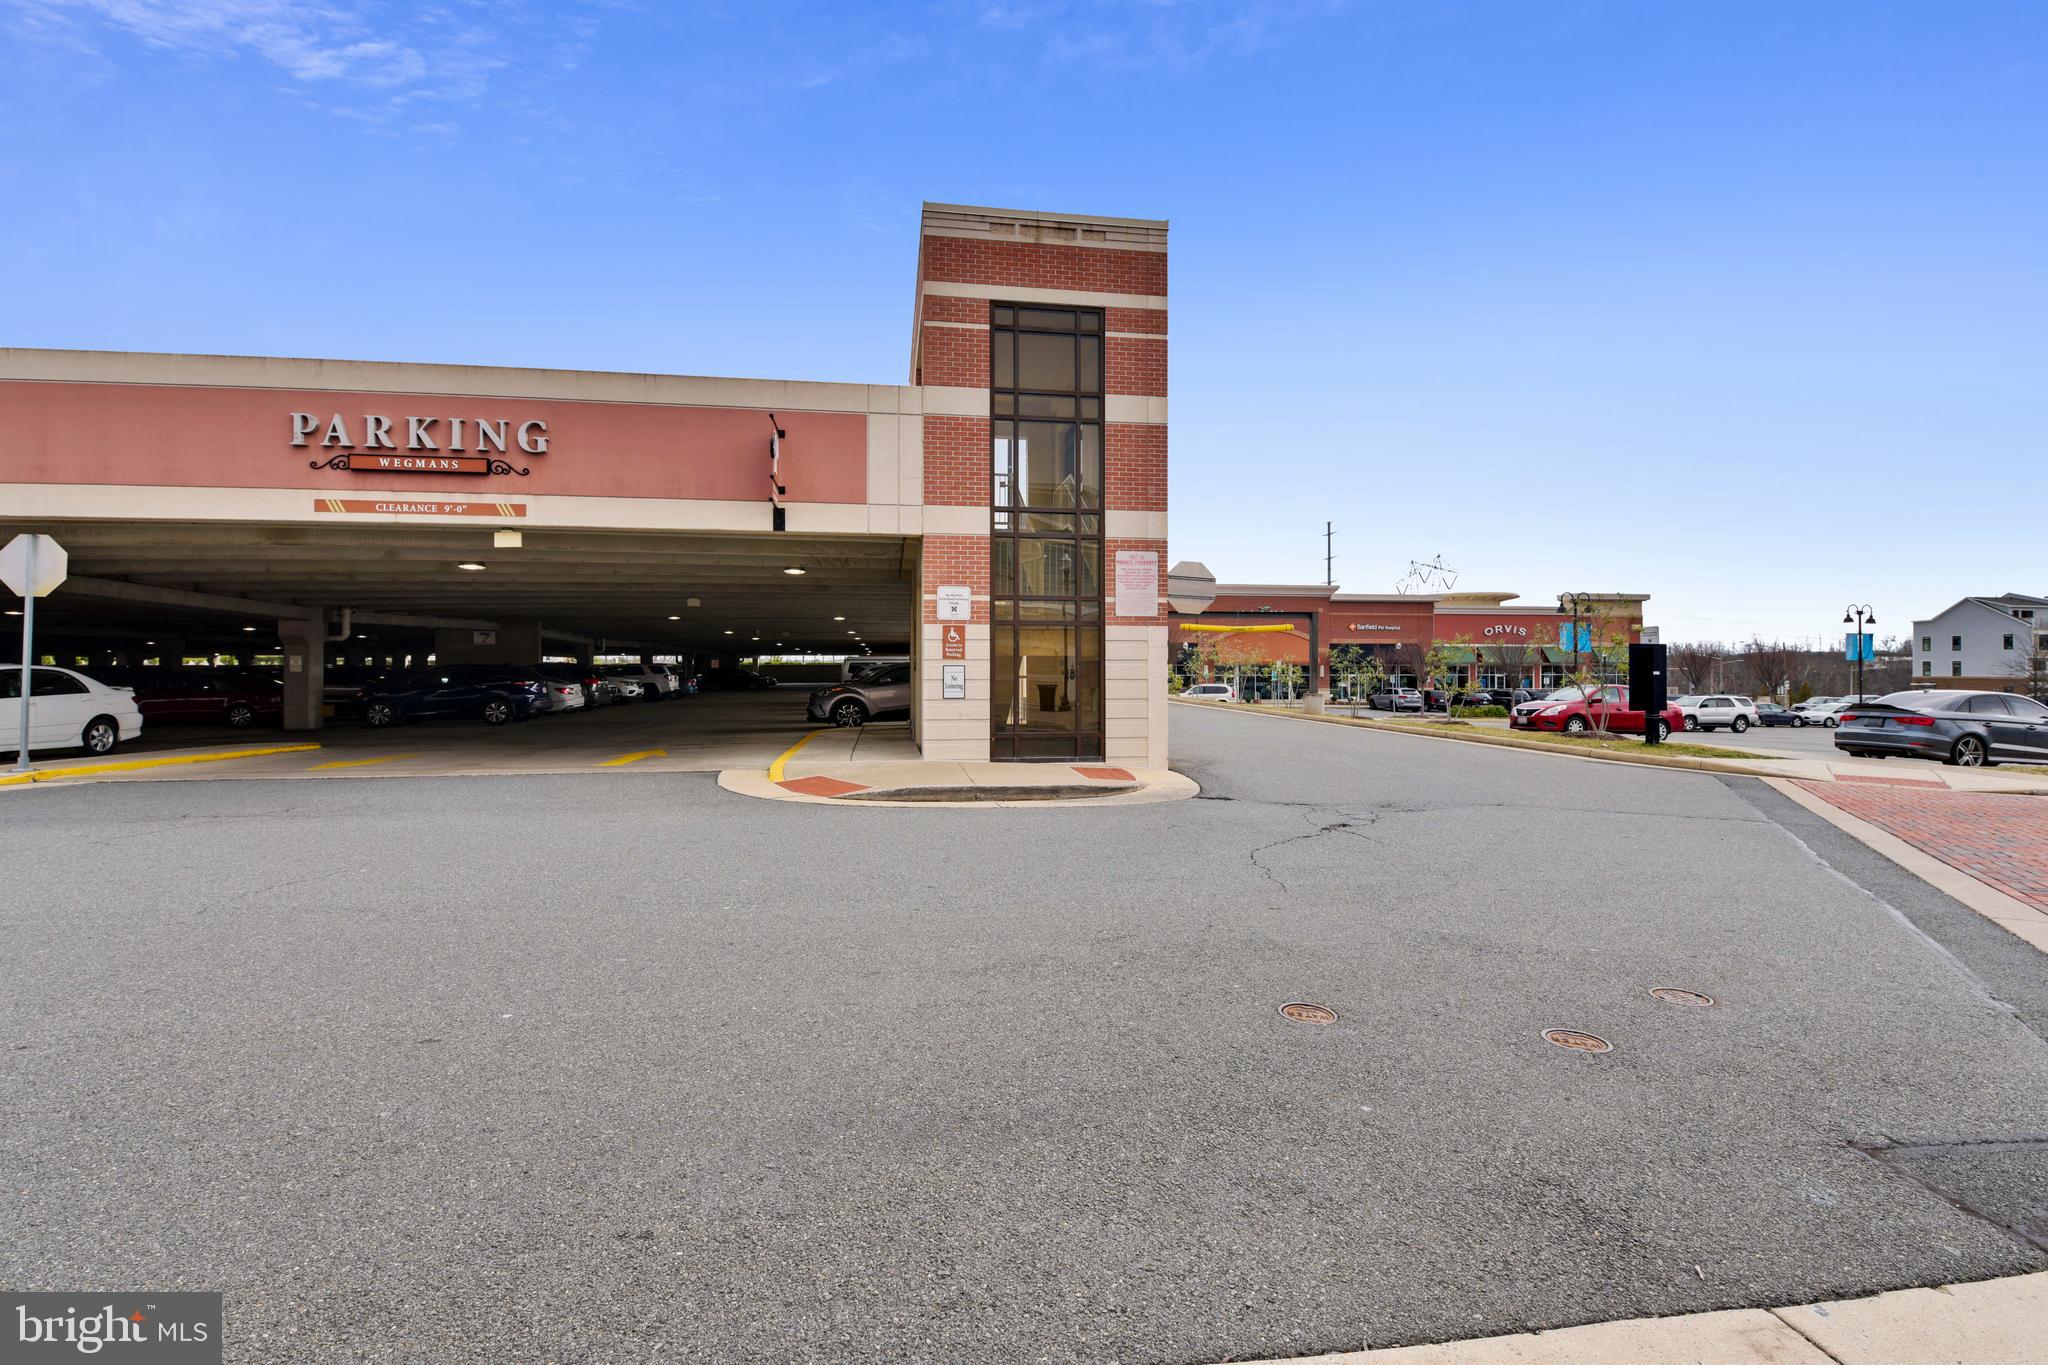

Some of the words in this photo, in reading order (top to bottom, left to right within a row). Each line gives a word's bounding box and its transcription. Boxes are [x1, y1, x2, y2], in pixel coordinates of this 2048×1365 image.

[289, 412, 550, 454] PARKING
[379, 457, 460, 470] WEGMANS
[375, 503, 438, 513] CLEARANCE
[1484, 624, 1527, 636] ORVIS
[480, 632, 490, 644] 7
